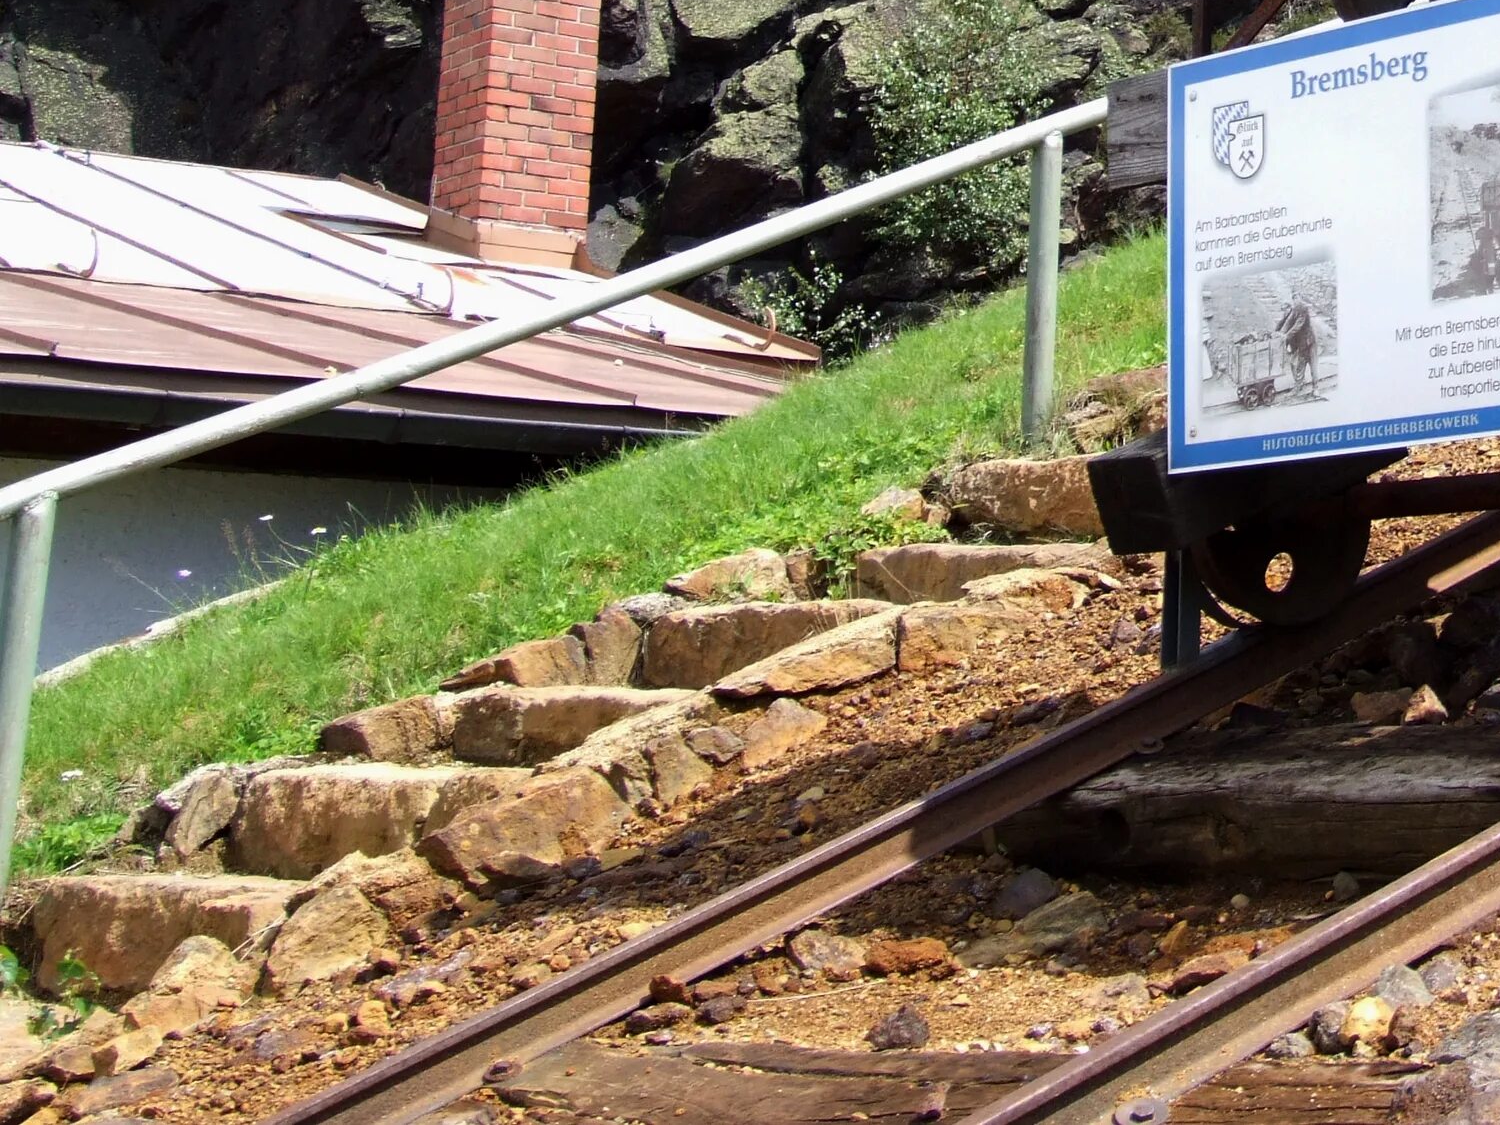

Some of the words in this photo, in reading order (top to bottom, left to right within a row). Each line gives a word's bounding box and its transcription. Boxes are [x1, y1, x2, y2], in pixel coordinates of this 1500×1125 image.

[1290, 51, 1428, 99] Bremsberg
[1236, 121, 1259, 135] Glück
[1241, 135, 1253, 147] auf
[1195, 219, 1213, 233] Am
[1215, 206, 1288, 229] Barbarastollen
[1195, 234, 1241, 252] kommen
[1243, 229, 1260, 244] die
[1262, 217, 1333, 241] Grubenhunte
[1195, 256, 1213, 272] auf
[1214, 253, 1235, 268] den
[1238, 245, 1293, 265] Bremsberg
[1395, 328, 1412, 342] Mit
[1415, 324, 1442, 339] dem
[1429, 342, 1448, 358] die
[1451, 340, 1475, 356] Erze
[1428, 365, 1445, 379] zur
[1262, 430, 1344, 452] HISTORISCHES
[1346, 413, 1479, 442] BESUCHERBERGWERK
